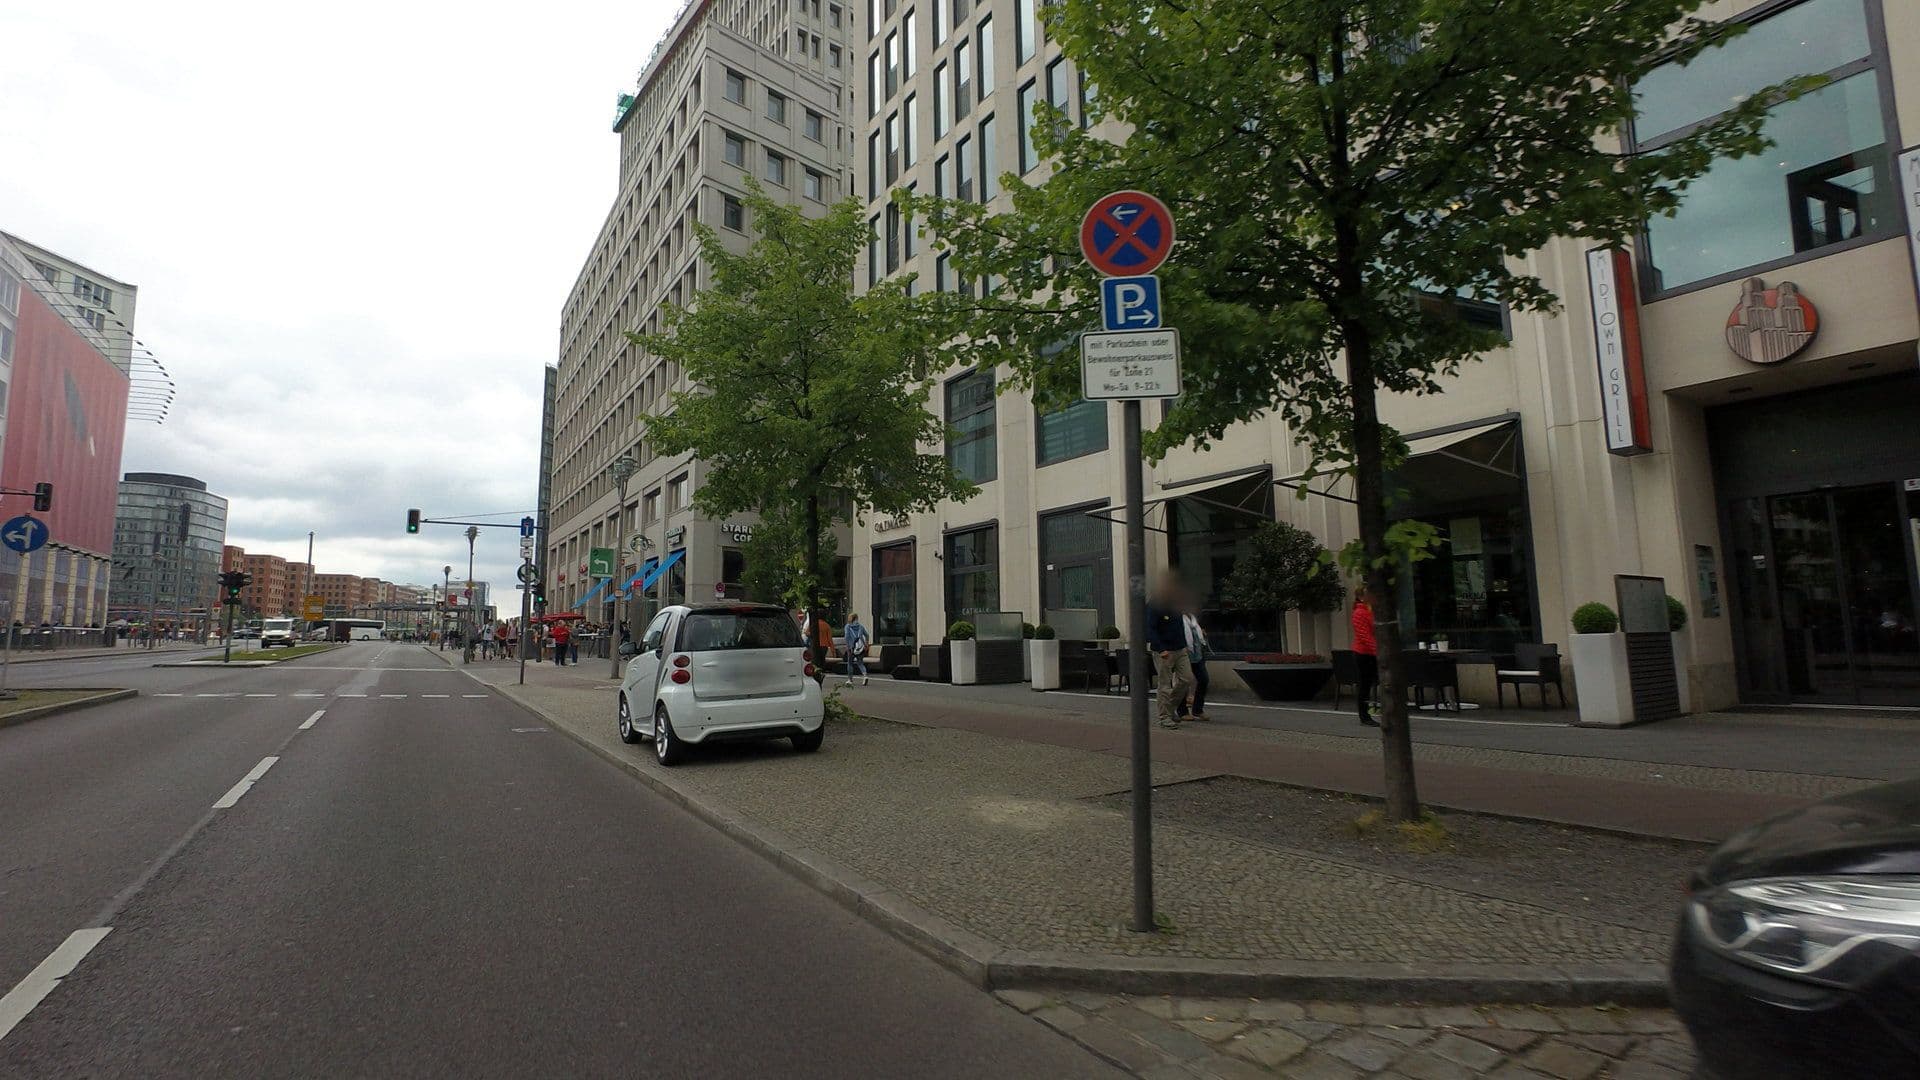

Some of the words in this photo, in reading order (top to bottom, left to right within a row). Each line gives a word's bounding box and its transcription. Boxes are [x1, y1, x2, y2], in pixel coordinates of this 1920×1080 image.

[1115, 283, 1146, 325] P
[1106, 339, 1148, 348] Parkschein
[1151, 338, 1168, 347] oder
[1087, 353, 1174, 364] Bewohnerparkausweis
[1109, 367, 1121, 376] für
[1125, 366, 1143, 377] Zone
[1609, 367, 1624, 443] GRILL
